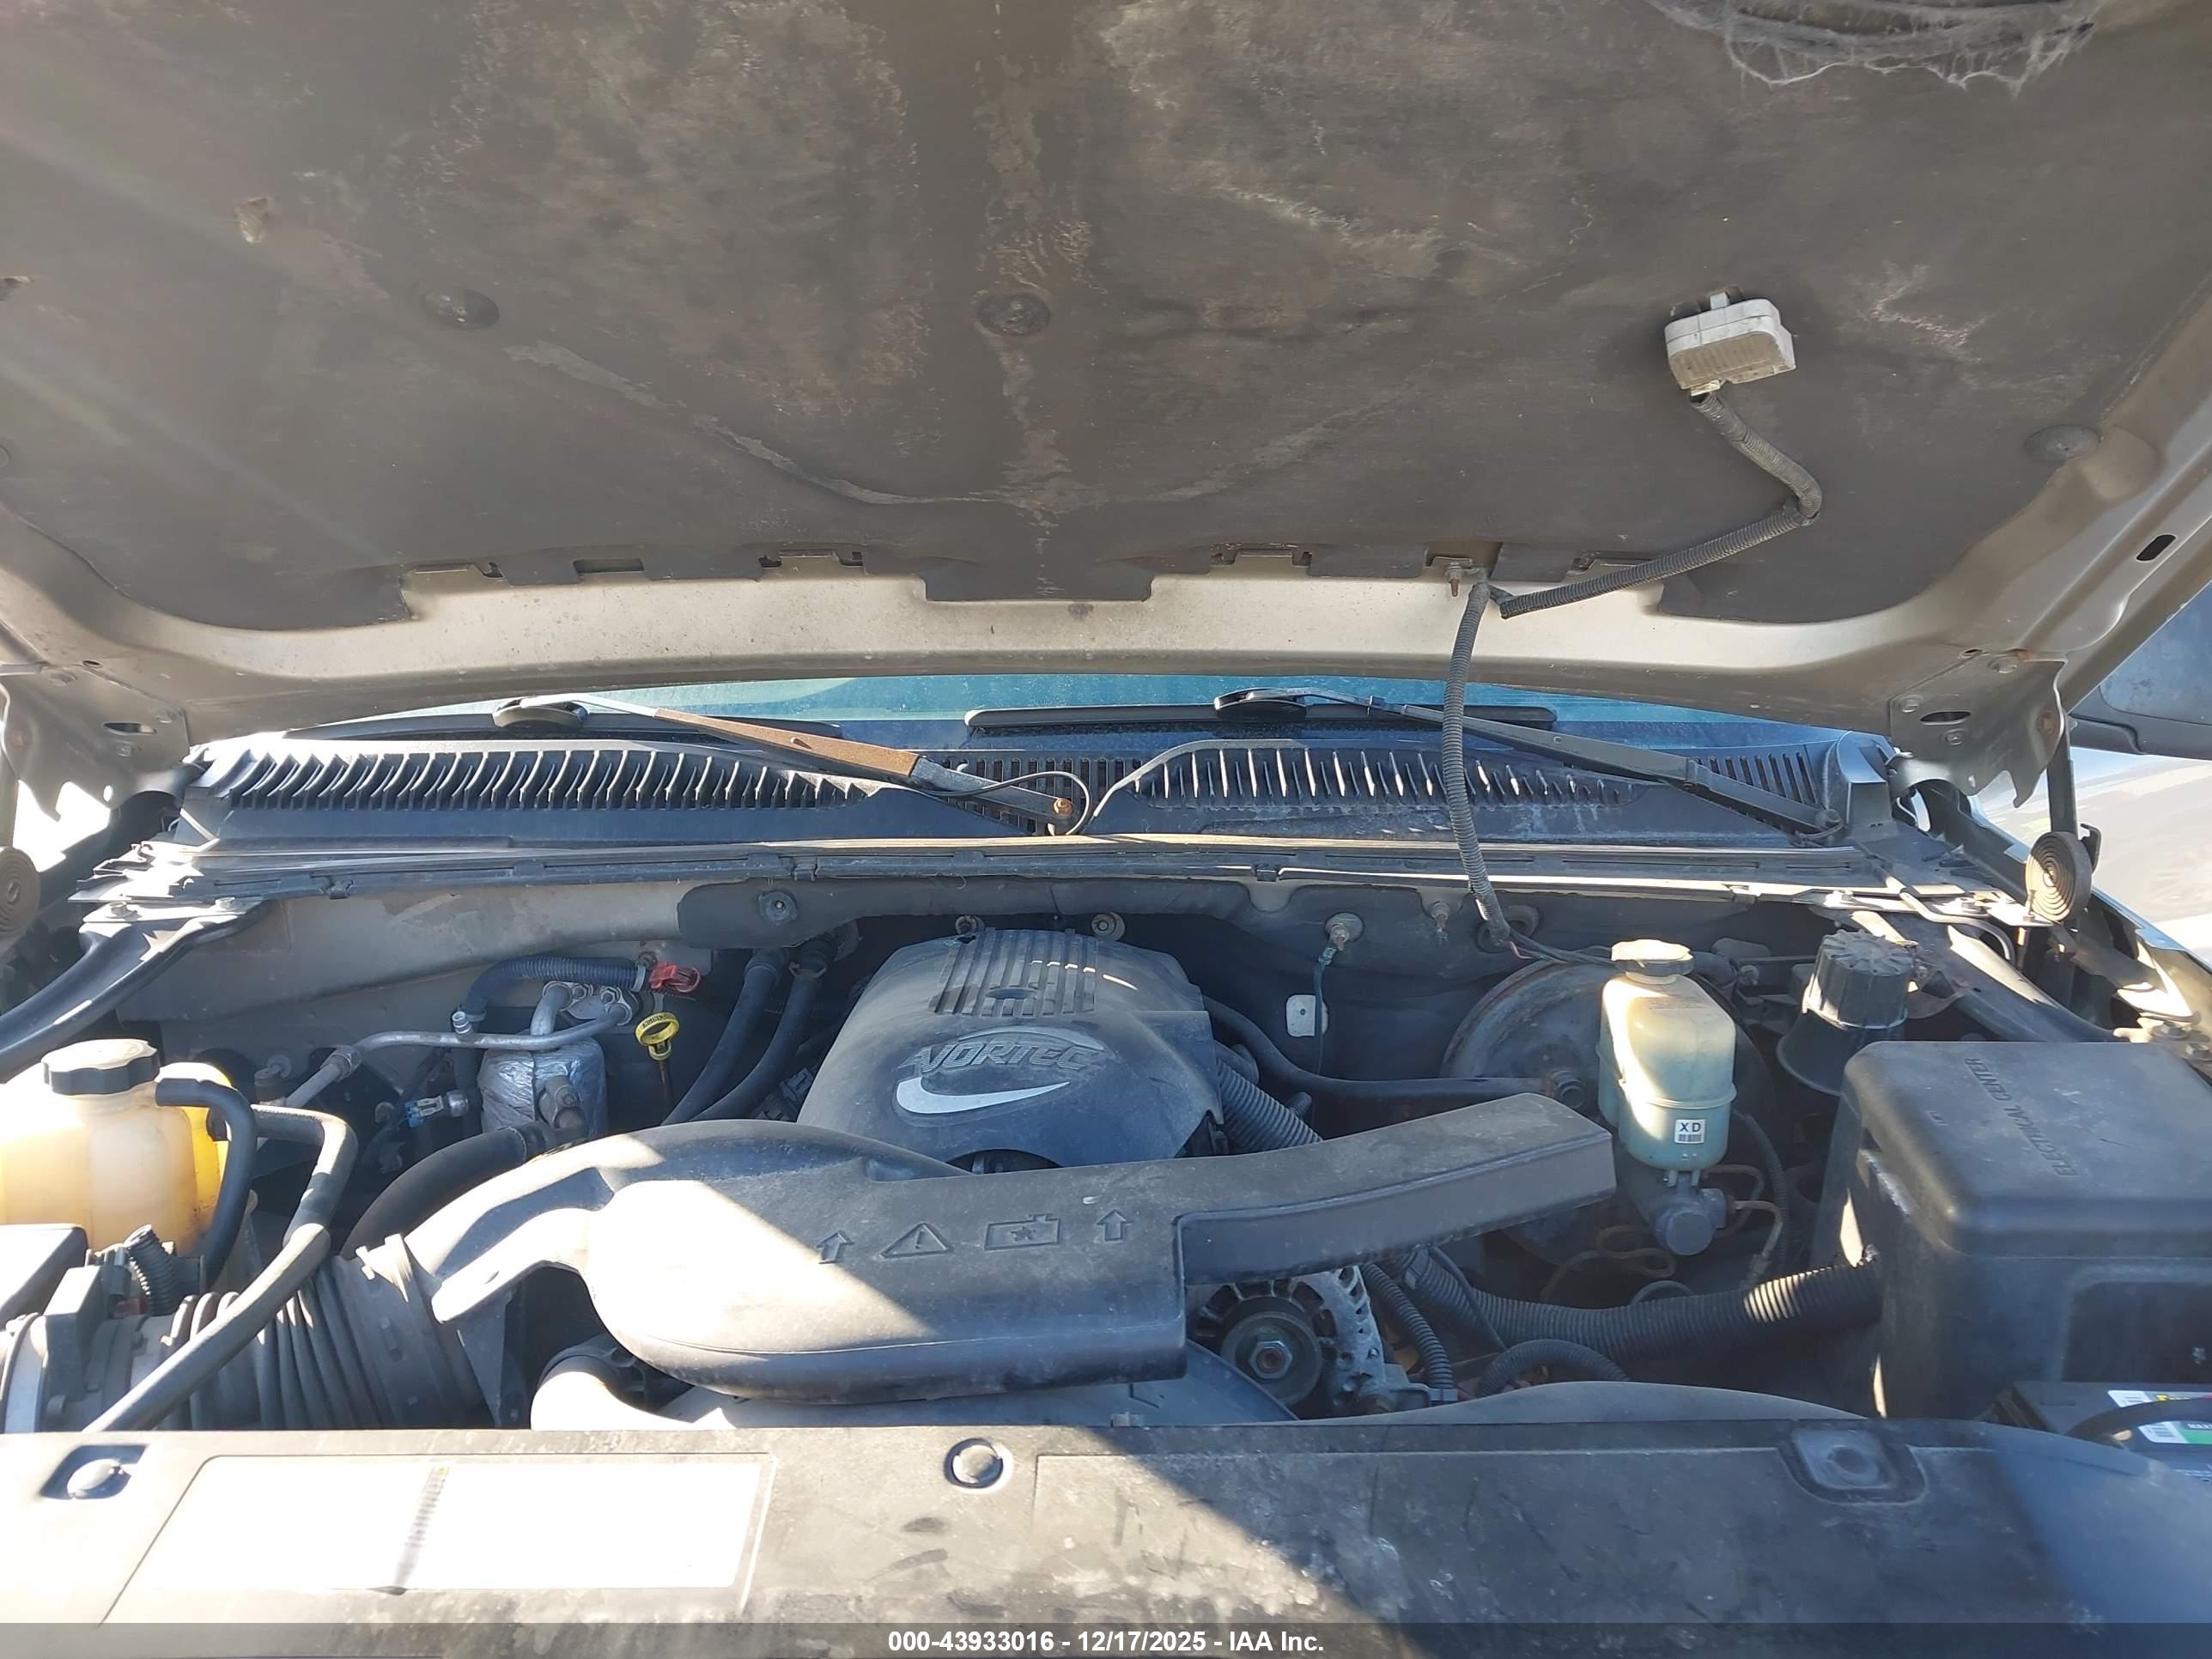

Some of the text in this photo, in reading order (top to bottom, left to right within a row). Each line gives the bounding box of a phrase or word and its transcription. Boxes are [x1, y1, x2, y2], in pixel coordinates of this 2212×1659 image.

[917, 1043, 1087, 1073] VORTEC
[1965, 1058, 2077, 1176] ELECTRICAL CENTER
